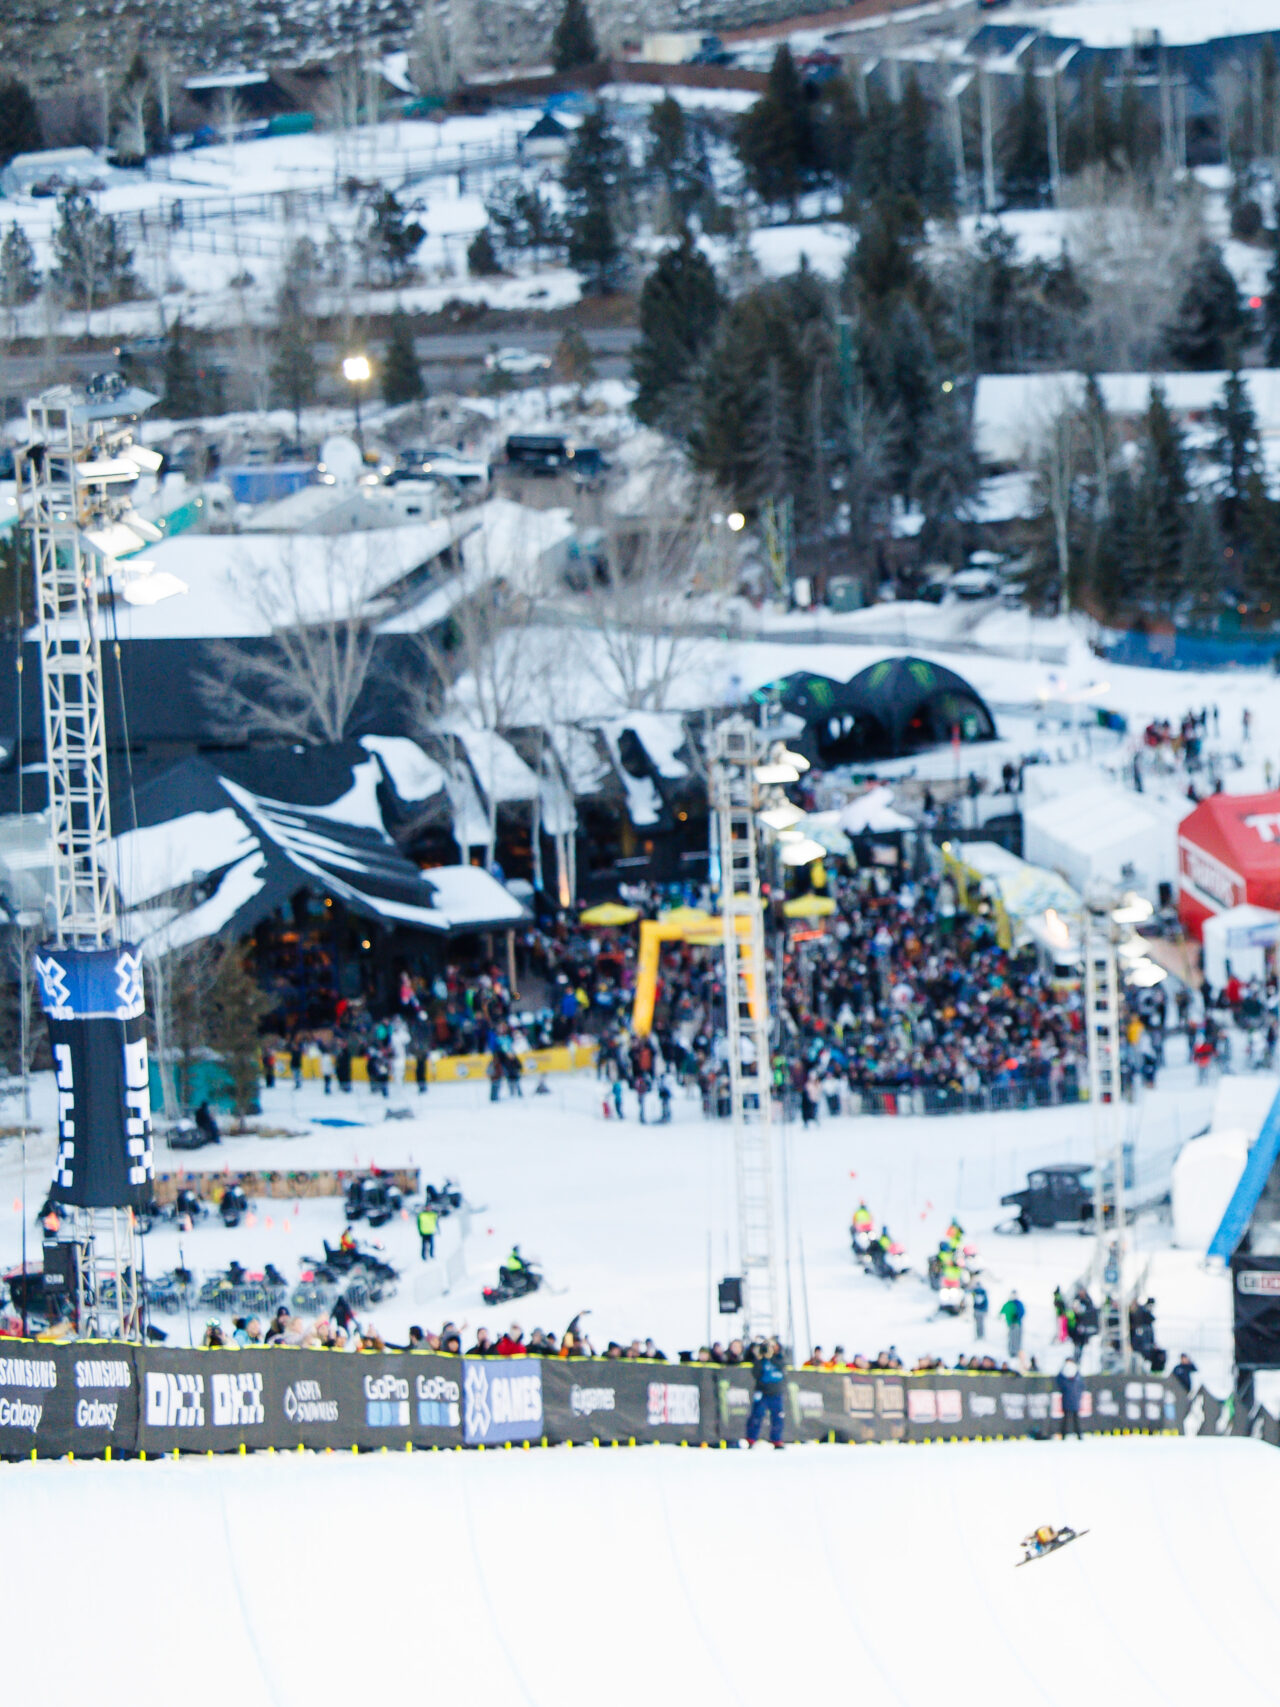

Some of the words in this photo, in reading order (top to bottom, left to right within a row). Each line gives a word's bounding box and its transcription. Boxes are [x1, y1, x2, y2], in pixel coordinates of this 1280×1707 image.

[0, 1358, 57, 1388] SAMSUNG
[76, 1360, 131, 1388] SAMSUNG
[364, 1375, 409, 1400] GoPro
[416, 1375, 460, 1400] GoPro
[146, 1371, 205, 1426] OKX
[212, 1373, 265, 1425] OKX
[491, 1375, 542, 1424] GAMES
[0, 1398, 43, 1433] Galaxy
[77, 1399, 118, 1431] Galaxy
